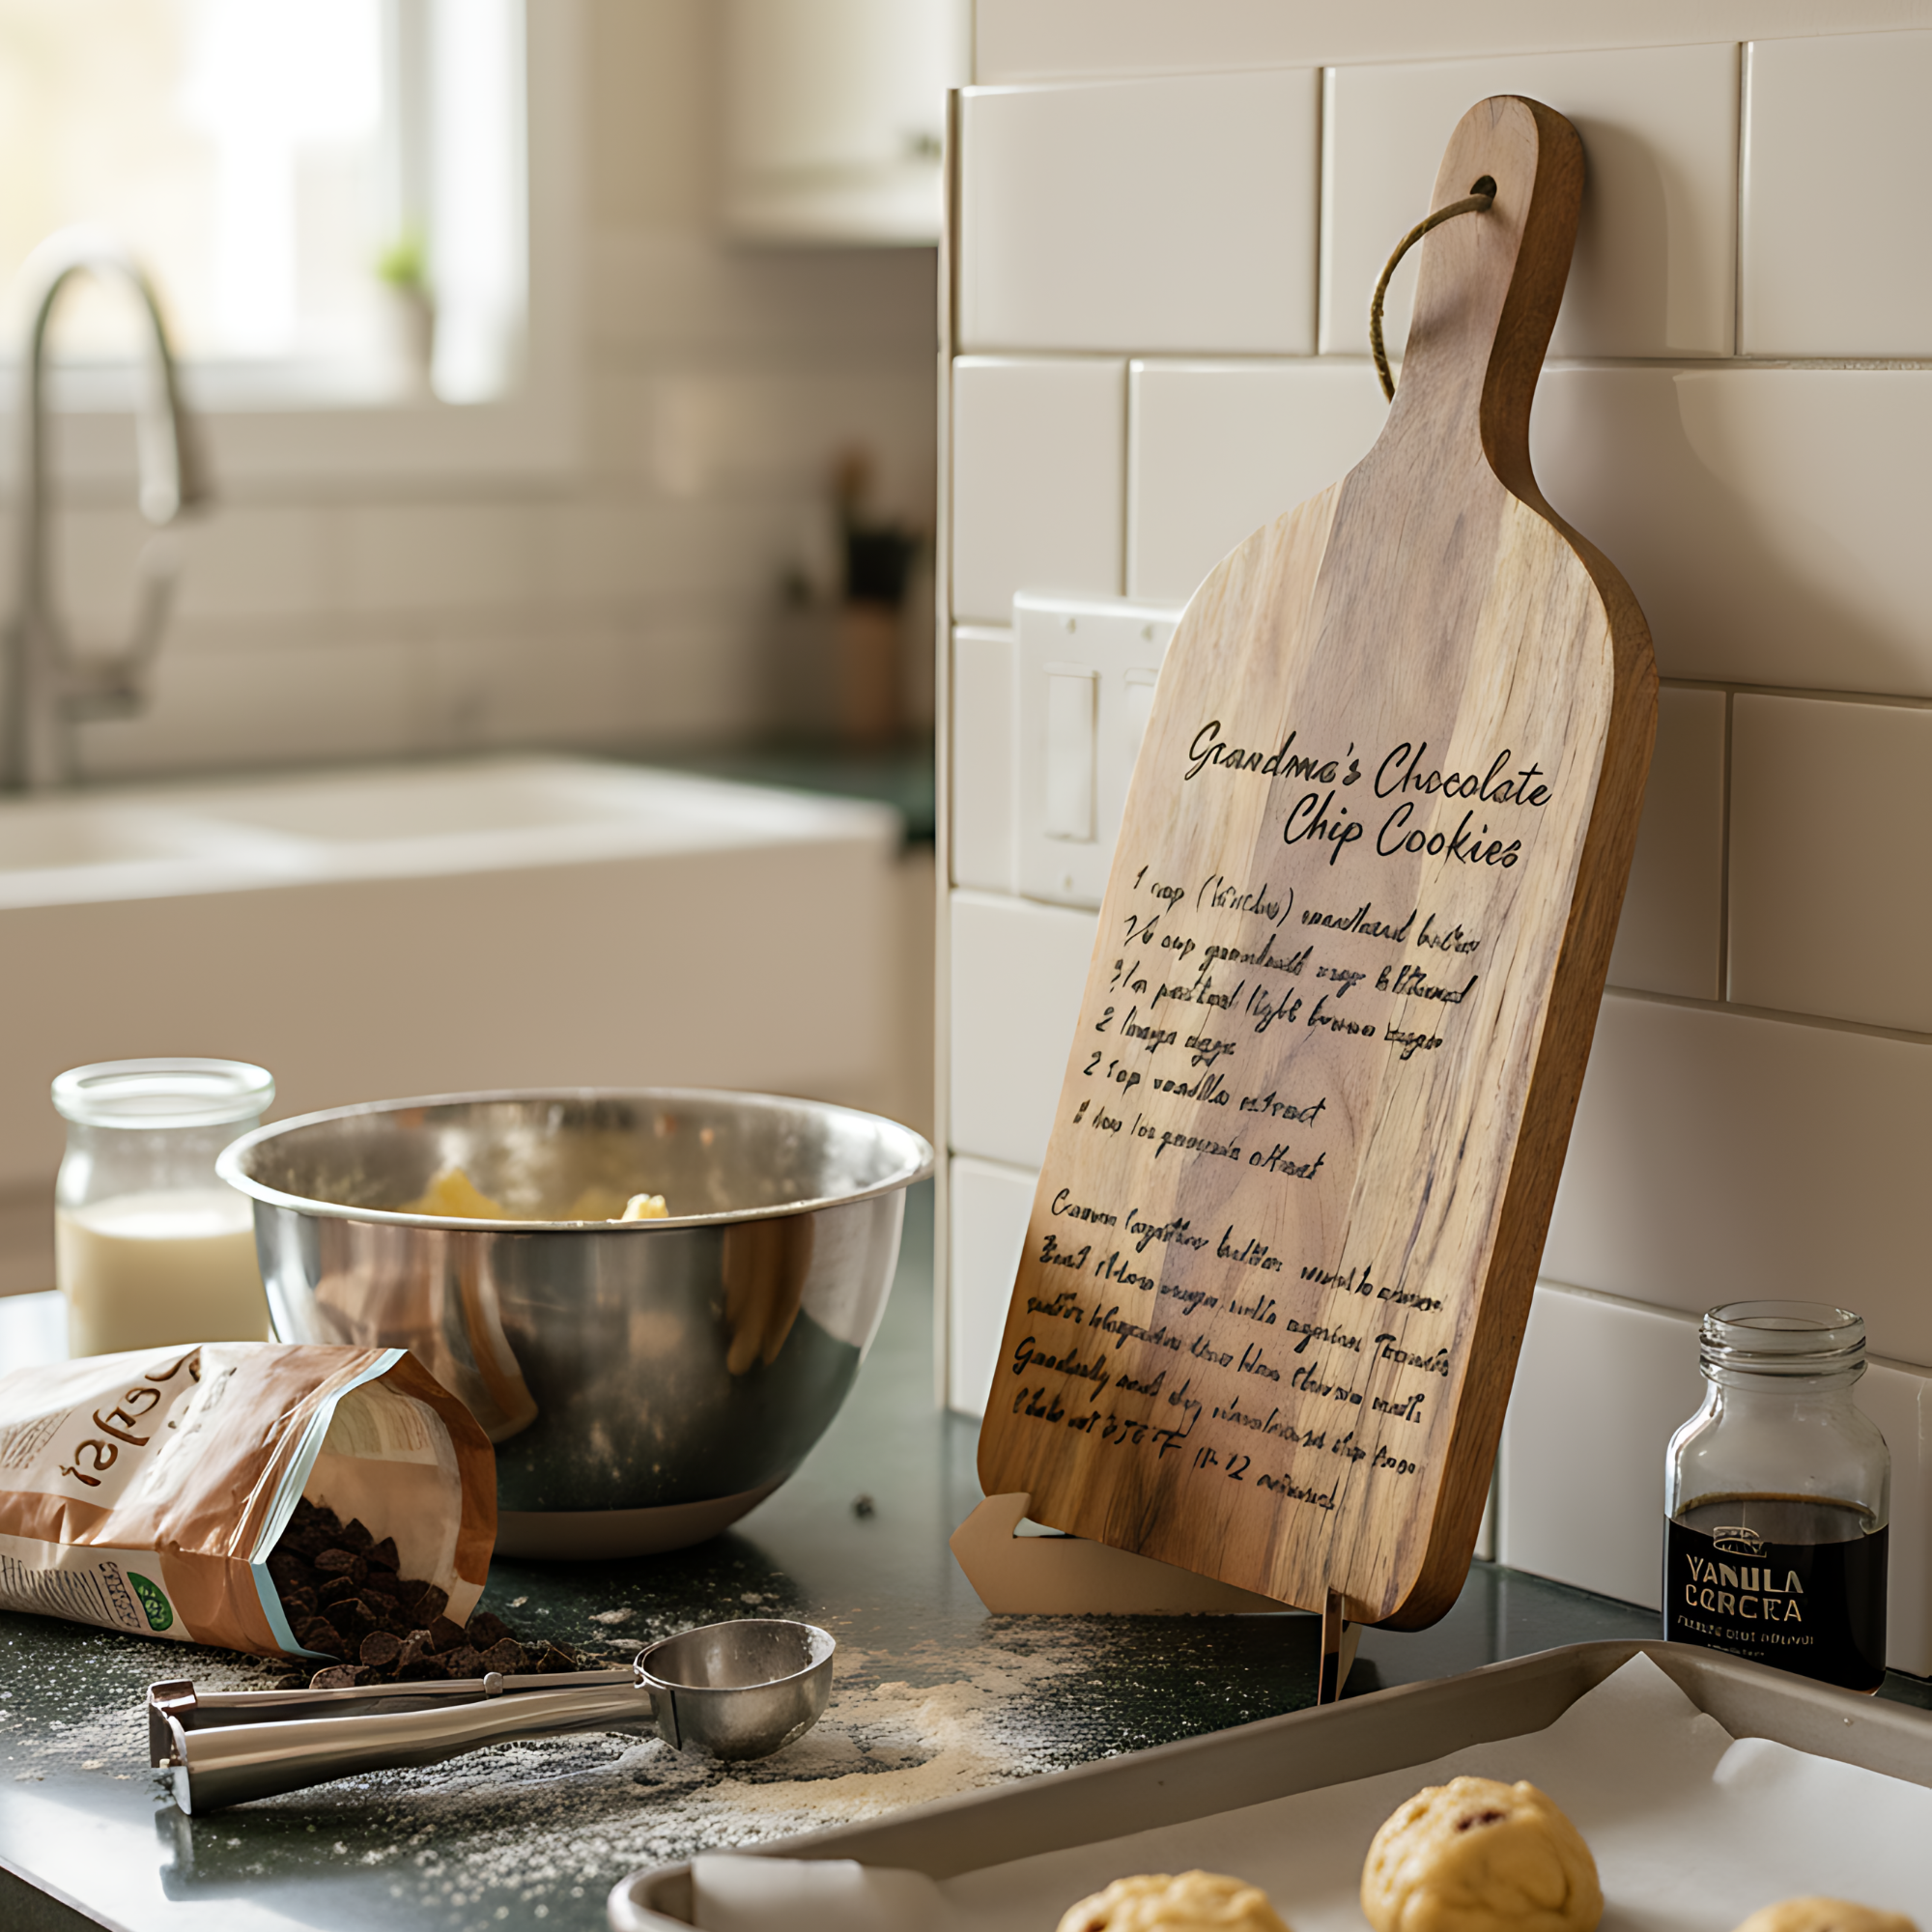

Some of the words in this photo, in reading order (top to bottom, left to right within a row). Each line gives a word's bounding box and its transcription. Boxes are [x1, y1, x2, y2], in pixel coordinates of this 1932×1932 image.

[1374, 742, 1553, 807] Chocolate
[1284, 790, 1363, 866] Chip
[1377, 802, 1522, 868] Cookies
[1083, 1050, 1103, 1076] 2
